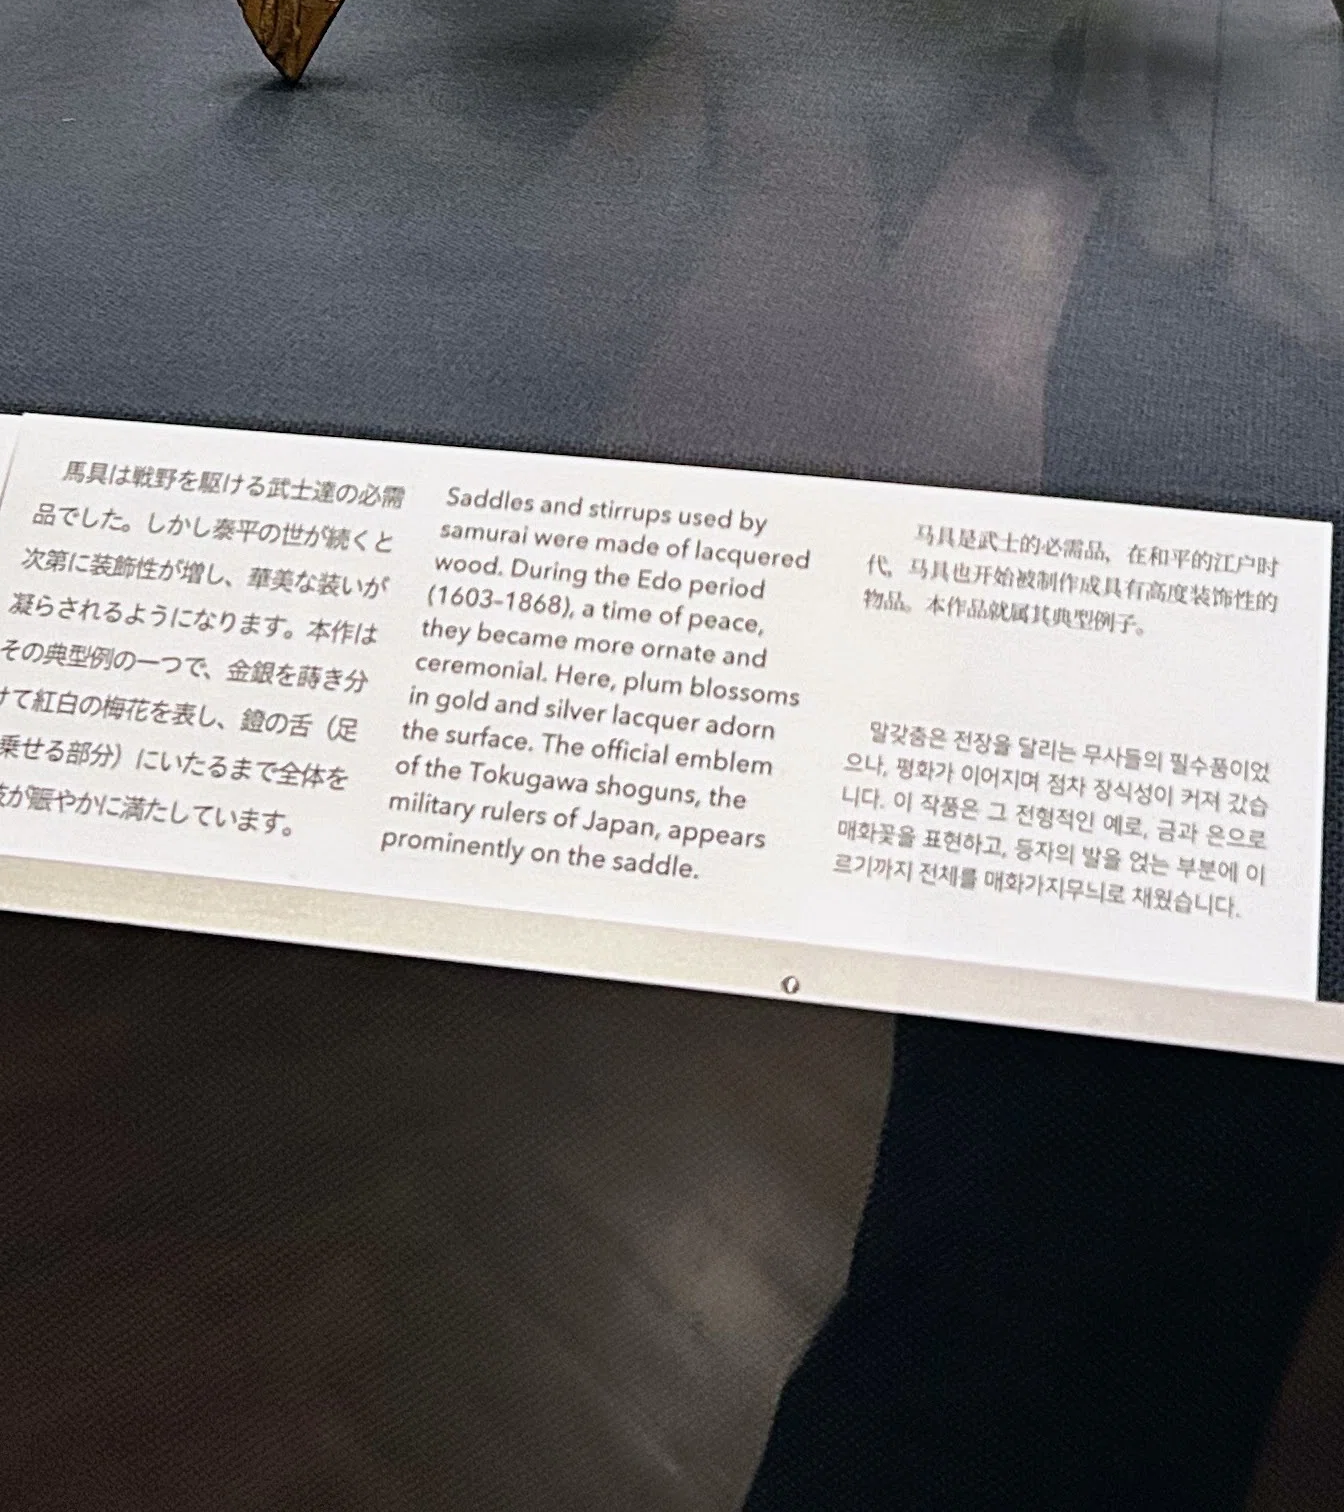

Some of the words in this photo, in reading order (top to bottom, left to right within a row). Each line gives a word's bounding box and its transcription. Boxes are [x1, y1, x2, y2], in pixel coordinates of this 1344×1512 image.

[446, 486, 534, 513] Saddles
[540, 496, 584, 517] and
[589, 499, 672, 528] stirrups
[678, 509, 733, 530] used
[739, 510, 768, 537] by
[440, 524, 529, 544] samurai
[534, 532, 589, 550] were
[595, 534, 660, 556] made
[666, 537, 692, 559] of
[695, 539, 811, 570] lacquered
[435, 555, 503, 576] wood.
[510, 557, 588, 589] During
[595, 564, 630, 588] the
[637, 568, 682, 593] Edo
[688, 577, 766, 600] period
[422, 617, 471, 646] they
[477, 621, 568, 650] became
[574, 637, 635, 656] more
[641, 642, 716, 664] ornate
[722, 648, 768, 669] and
[581, 603, 595, 618] a
[602, 600, 652, 624] time
[659, 604, 684, 626] of
[687, 613, 763, 636] peace,
[415, 656, 547, 682] ceremonial.
[555, 664, 616, 692] Here,
[622, 670, 683, 696] plum
[690, 675, 800, 707] blossoms
[409, 685, 429, 706] in
[435, 689, 490, 714] gold
[494, 696, 540, 717] and
[544, 698, 607, 723] silver
[612, 703, 701, 735] lacquer
[705, 714, 775, 740] adorn
[402, 719, 439, 742] the
[445, 725, 533, 752] surface.
[542, 732, 585, 757] The
[590, 737, 669, 766] official
[675, 748, 773, 775] emblem
[870, 721, 947, 750] 말갖춤은
[953, 730, 1012, 757] 전장을
[1018, 736, 1077, 764] 달리는
[1082, 743, 1163, 773] 무사들의
[1170, 752, 1270, 784] 필수품이었
[395, 754, 422, 776] of
[425, 757, 462, 781] the
[470, 761, 589, 795] Tokugawa
[595, 774, 701, 809] shoguns,
[709, 785, 747, 810] the
[844, 752, 887, 777] 으나,
[896, 757, 954, 784] 평화가
[961, 764, 1040, 793] 이어지며
[1047, 773, 1086, 798] 점차
[1093, 779, 1173, 808] 장식성이
[1181, 788, 1221, 813] 커져
[1228, 792, 1269, 818] 갔습
[388, 791, 476, 824] military
[480, 800, 547, 826] rulers
[553, 806, 580, 829] of
[582, 809, 660, 841] Japan,
[667, 824, 766, 849] appears
[841, 786, 885, 810] 니다.
[893, 791, 913, 813] 이
[920, 793, 979, 821] 작품은
[987, 802, 1007, 822] 그
[1016, 804, 1095, 834] 전형적인
[1103, 814, 1148, 840] 예로,
[1157, 819, 1199, 844] 금과
[1206, 824, 1267, 850] 은으로
[380, 831, 525, 866] prominently
[530, 847, 560, 864] on
[568, 844, 606, 870] the
[612, 852, 699, 879] saddle.
[837, 819, 916, 849] 매화꽃을
[922, 829, 1007, 859] 표현하고,
[1015, 838, 1075, 866] 등자의
[1082, 846, 1122, 872] 발을
[1129, 850, 1169, 877] 얹는
[1176, 856, 1238, 884] 부분에
[1246, 864, 1265, 887] 이
[833, 853, 914, 883] 르기까지
[918, 862, 978, 891] 전체를
[983, 870, 1125, 905] 매화가지무늬로
[1132, 886, 1240, 918] 채웠습니다.
